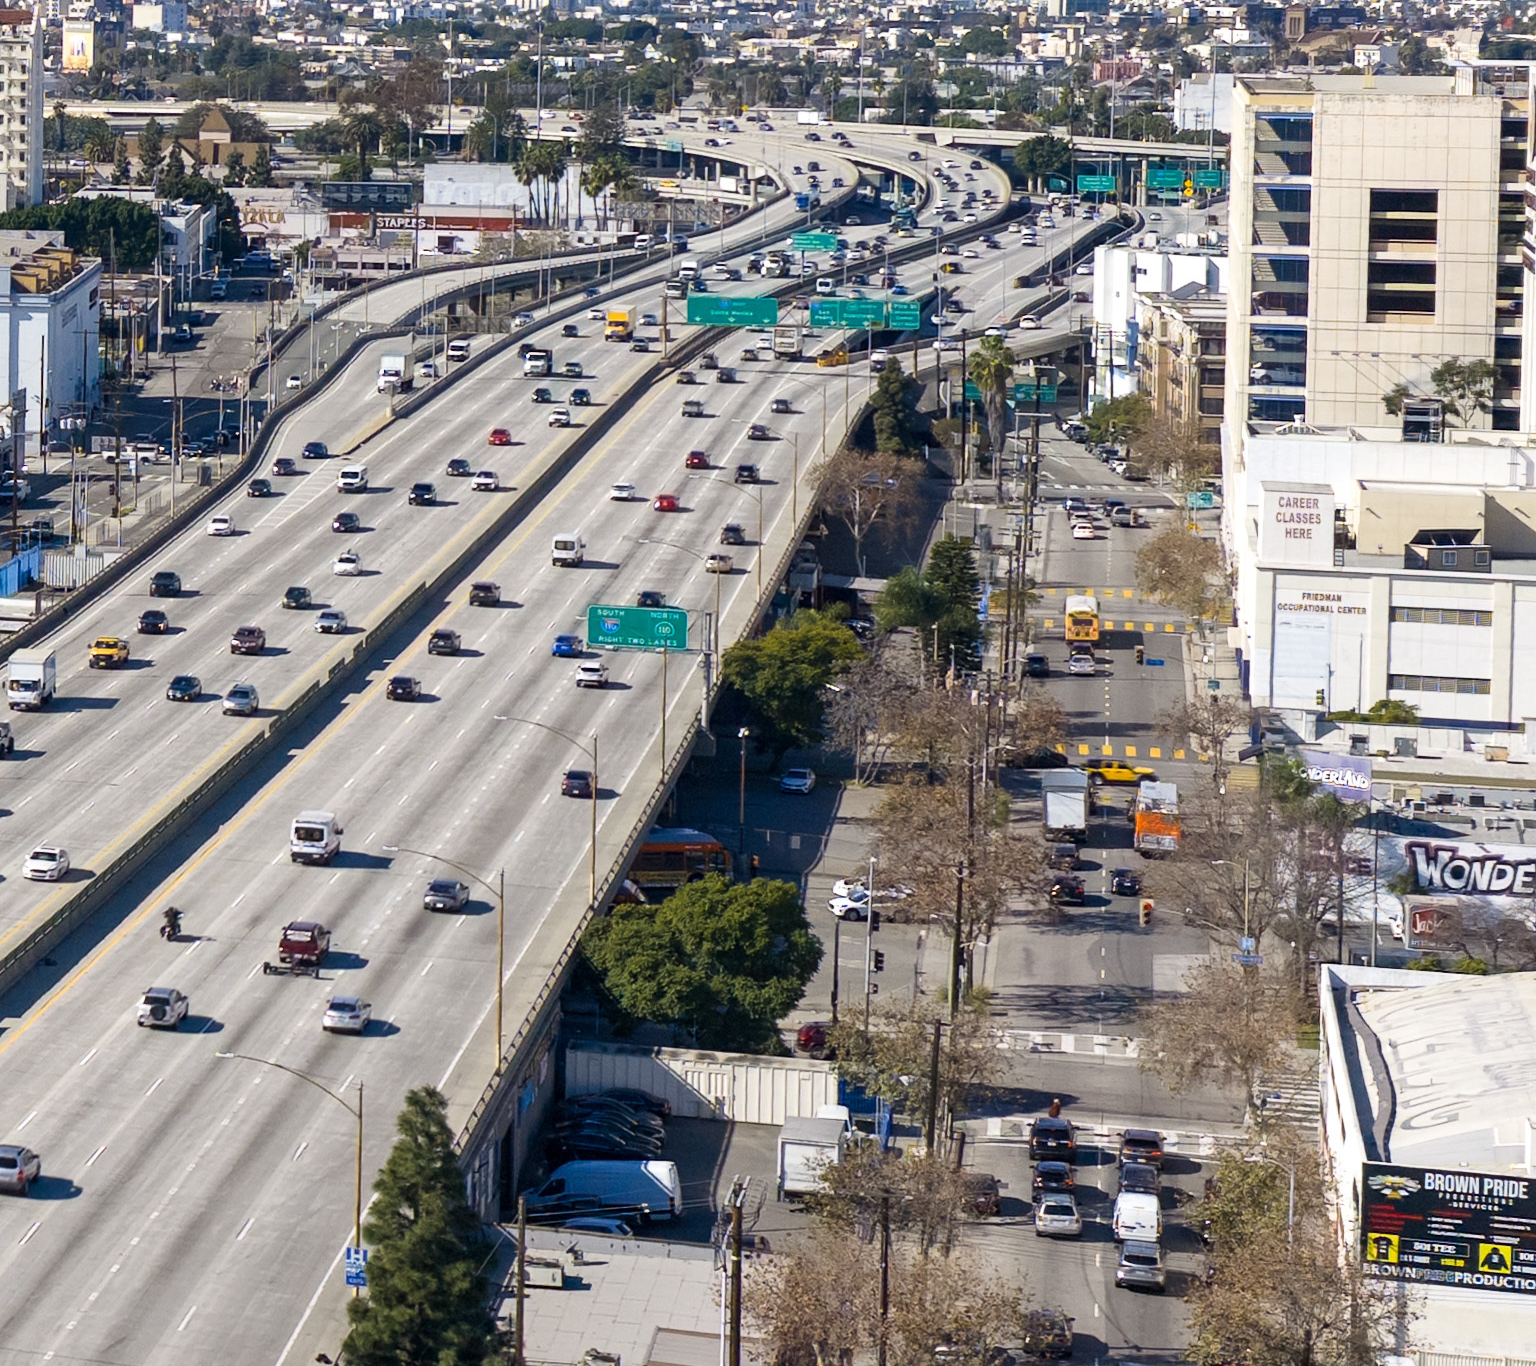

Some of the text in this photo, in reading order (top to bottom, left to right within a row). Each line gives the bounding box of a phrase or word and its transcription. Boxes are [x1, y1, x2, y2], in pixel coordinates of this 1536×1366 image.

[377, 217, 426, 229] STAPLES
[1278, 496, 1319, 510] CAREER
[1276, 512, 1321, 524] CLASSES
[1285, 527, 1313, 540] HERE
[1302, 592, 1342, 603] FRIEDMAN
[1277, 602, 1367, 615] OCCUPATIONAL CENTER
[598, 635, 623, 643] RIGHT
[1425, 1173, 1529, 1199] BROWN PRIDE
